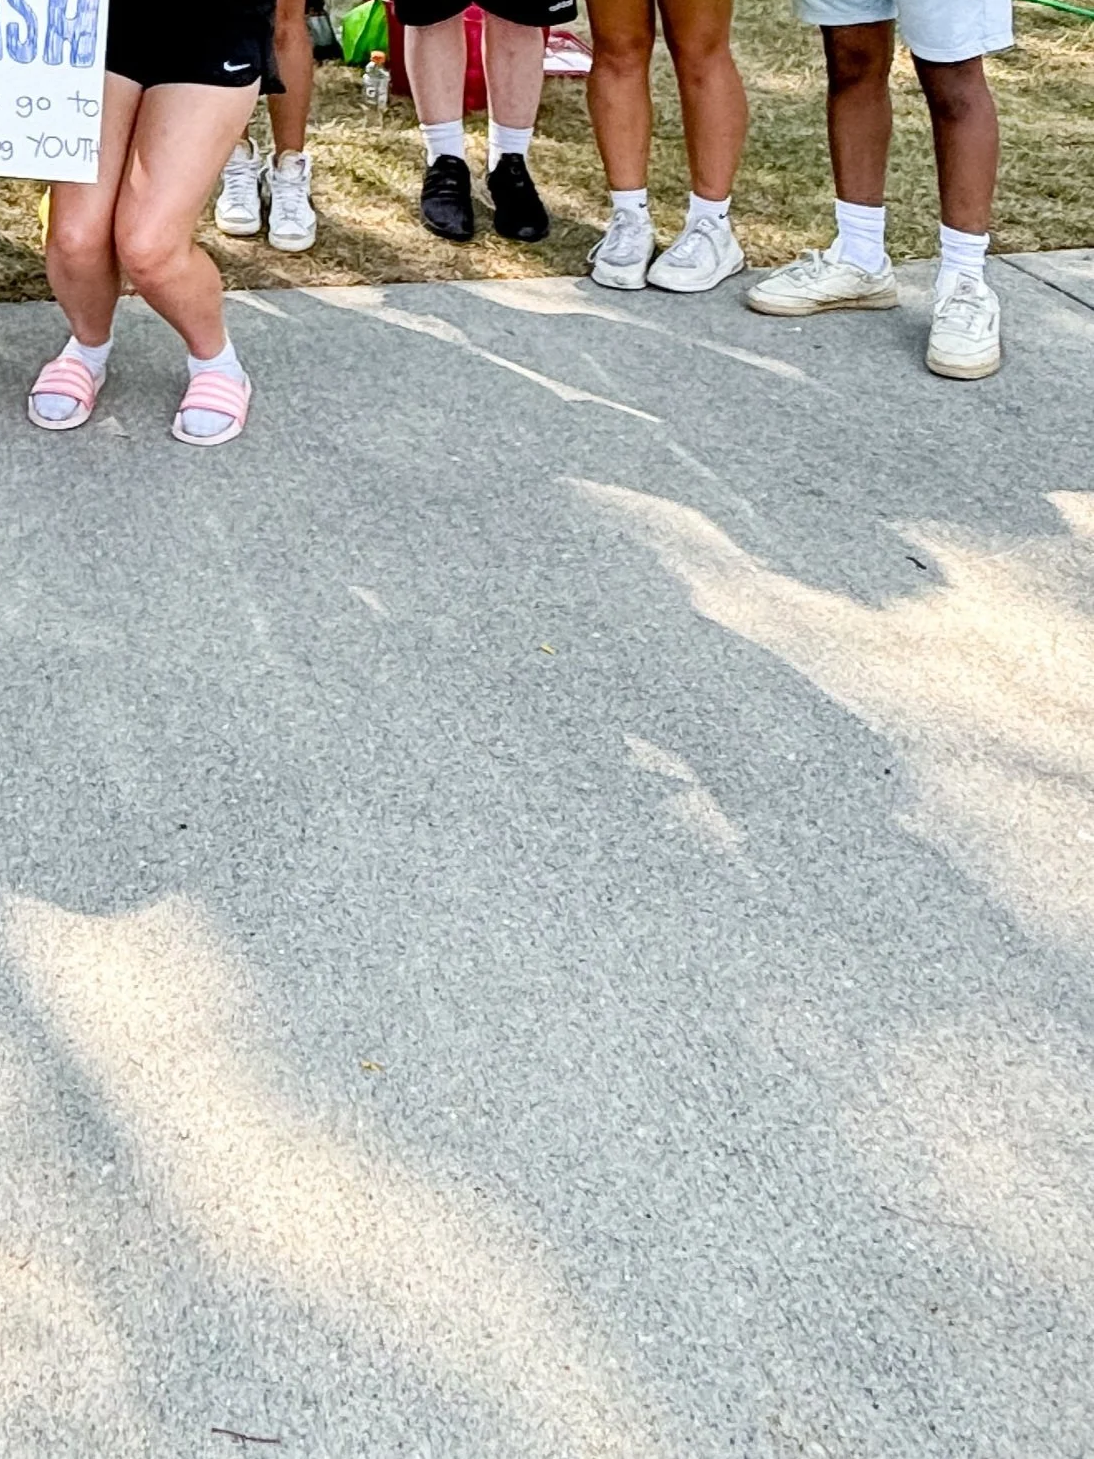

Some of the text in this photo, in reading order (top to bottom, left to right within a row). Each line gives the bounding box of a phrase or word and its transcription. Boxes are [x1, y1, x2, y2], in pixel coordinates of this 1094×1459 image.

[15, 95, 52, 119] go
[66, 89, 100, 118] to
[25, 131, 101, 164] YOUTH
